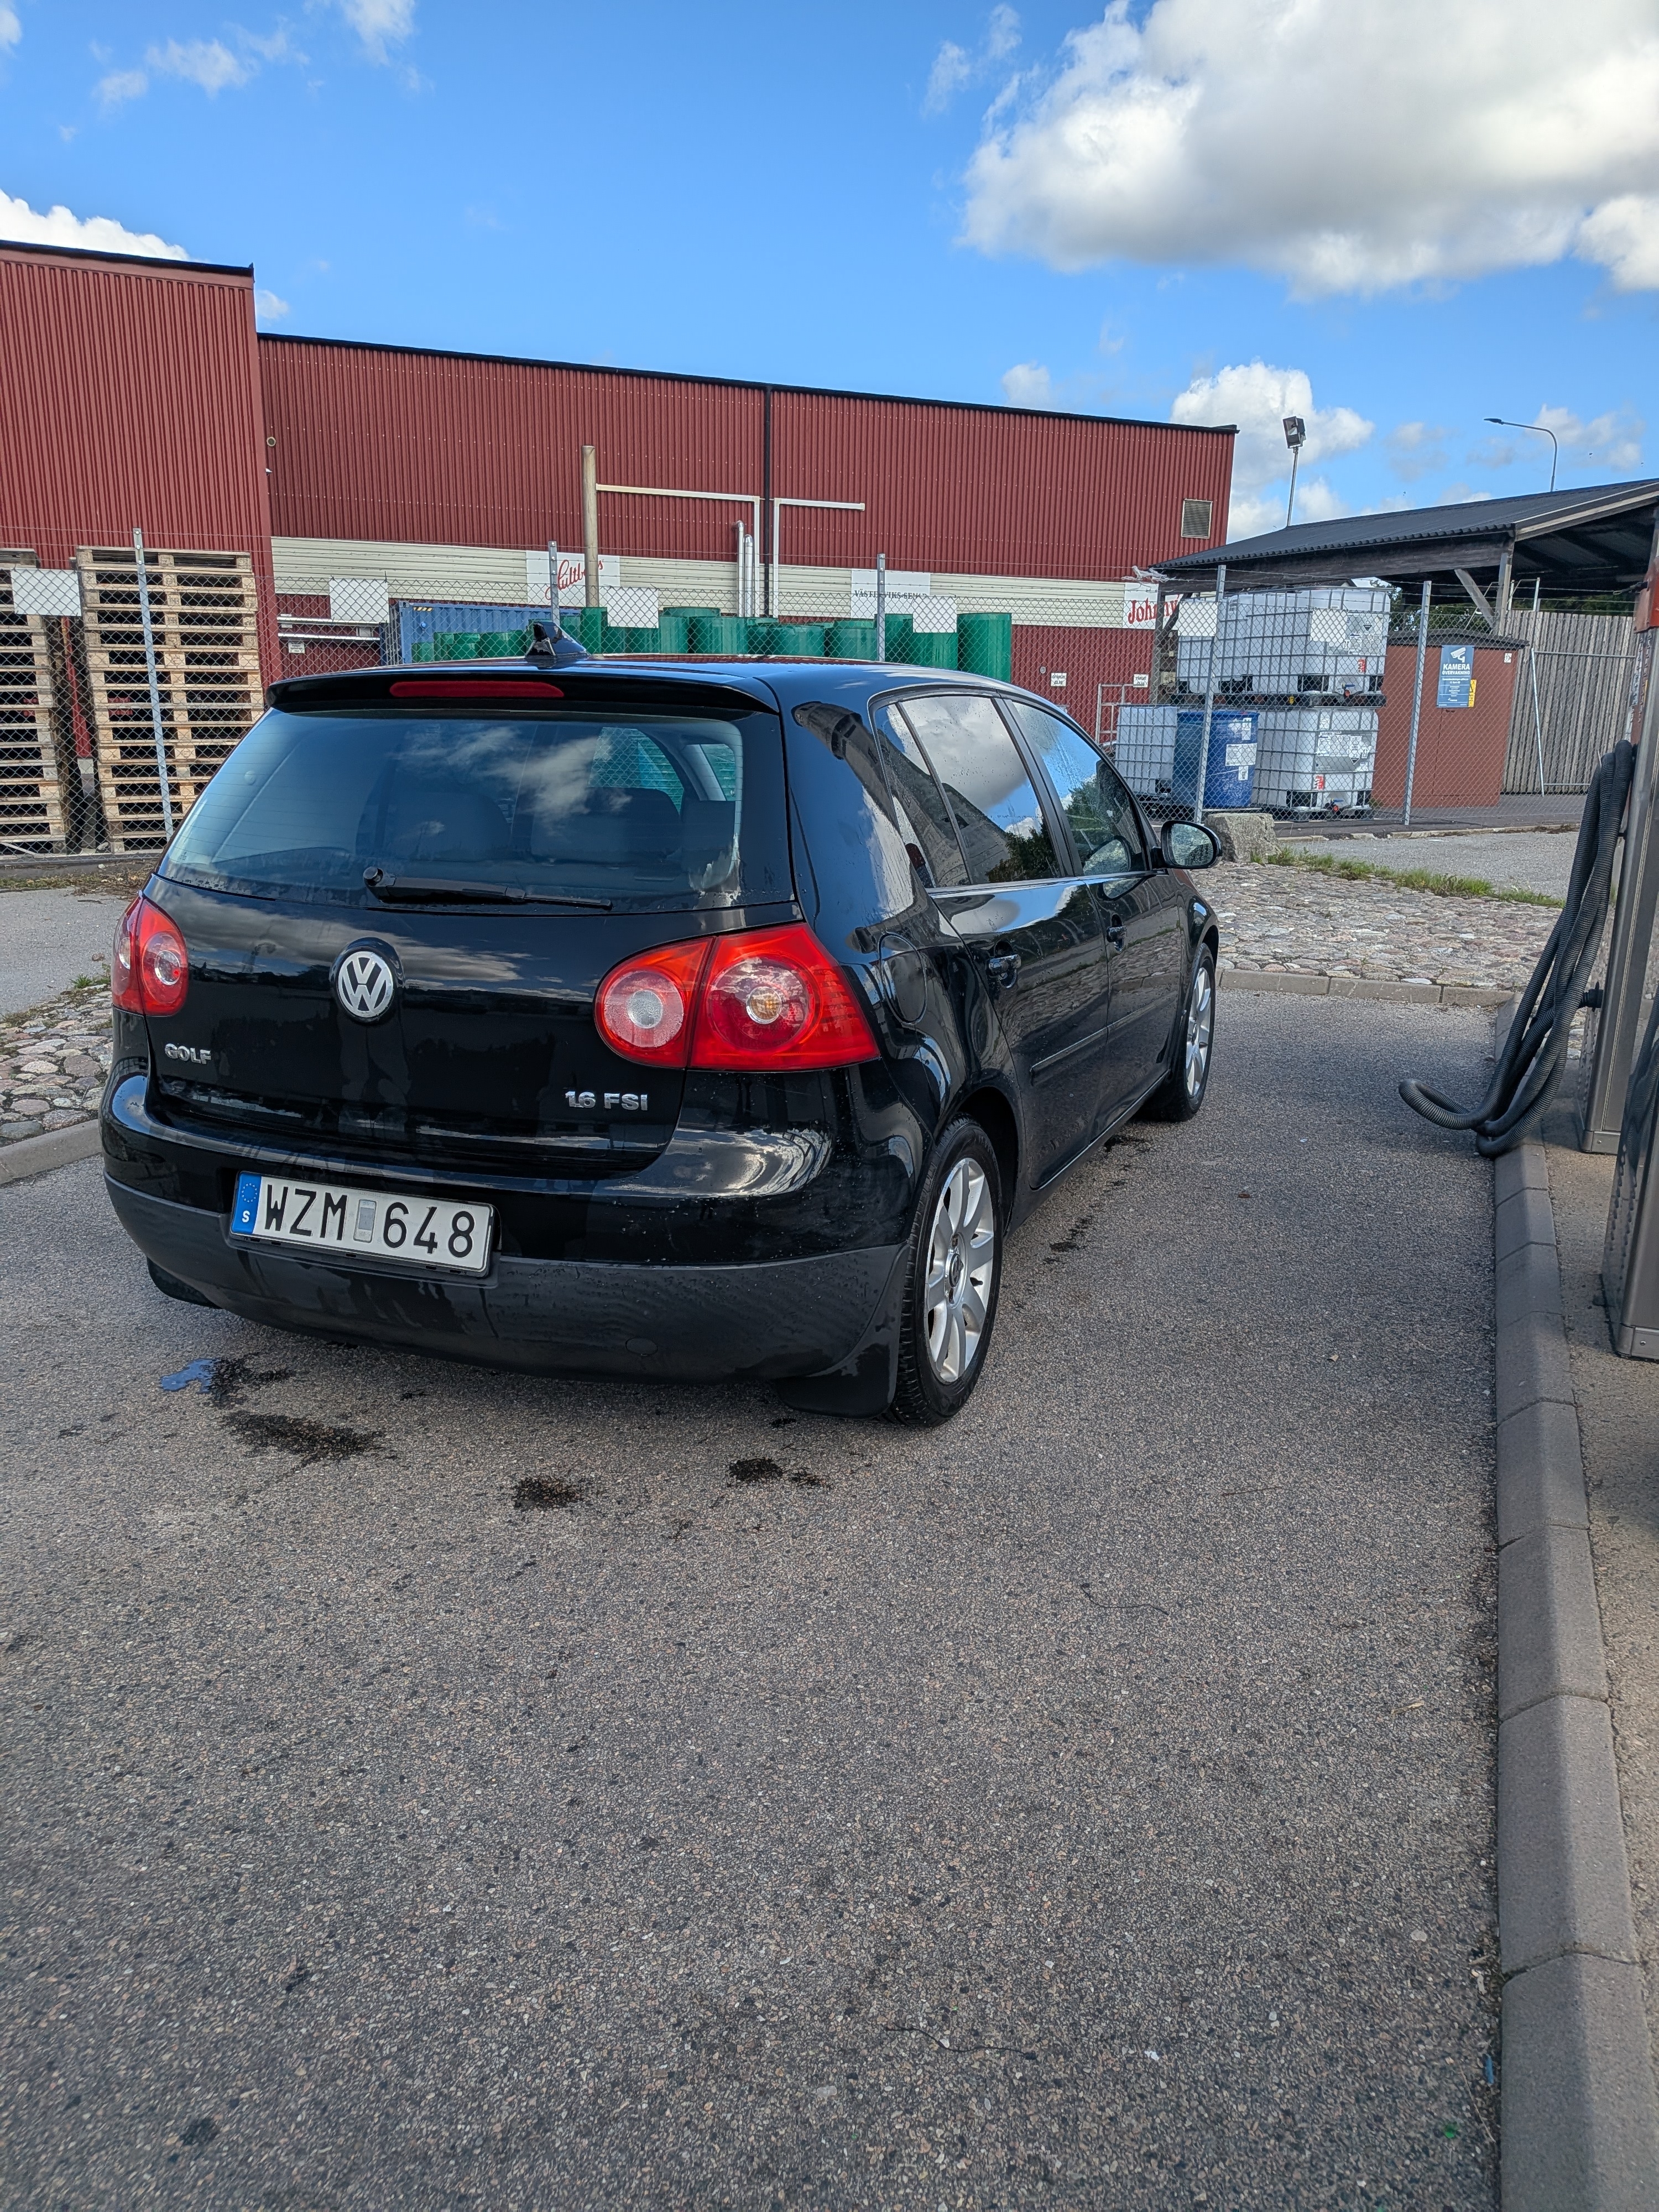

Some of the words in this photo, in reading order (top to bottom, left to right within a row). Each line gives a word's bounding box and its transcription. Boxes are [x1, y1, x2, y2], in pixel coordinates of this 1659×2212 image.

[545, 559, 603, 600] Hultbs
[338, 951, 393, 1018] VW
[165, 1043, 212, 1065] GOLF
[604, 1093, 648, 1111] FSI
[242, 1211, 251, 1223] S
[264, 1184, 348, 1241] WZM
[383, 1202, 476, 1259] 648
